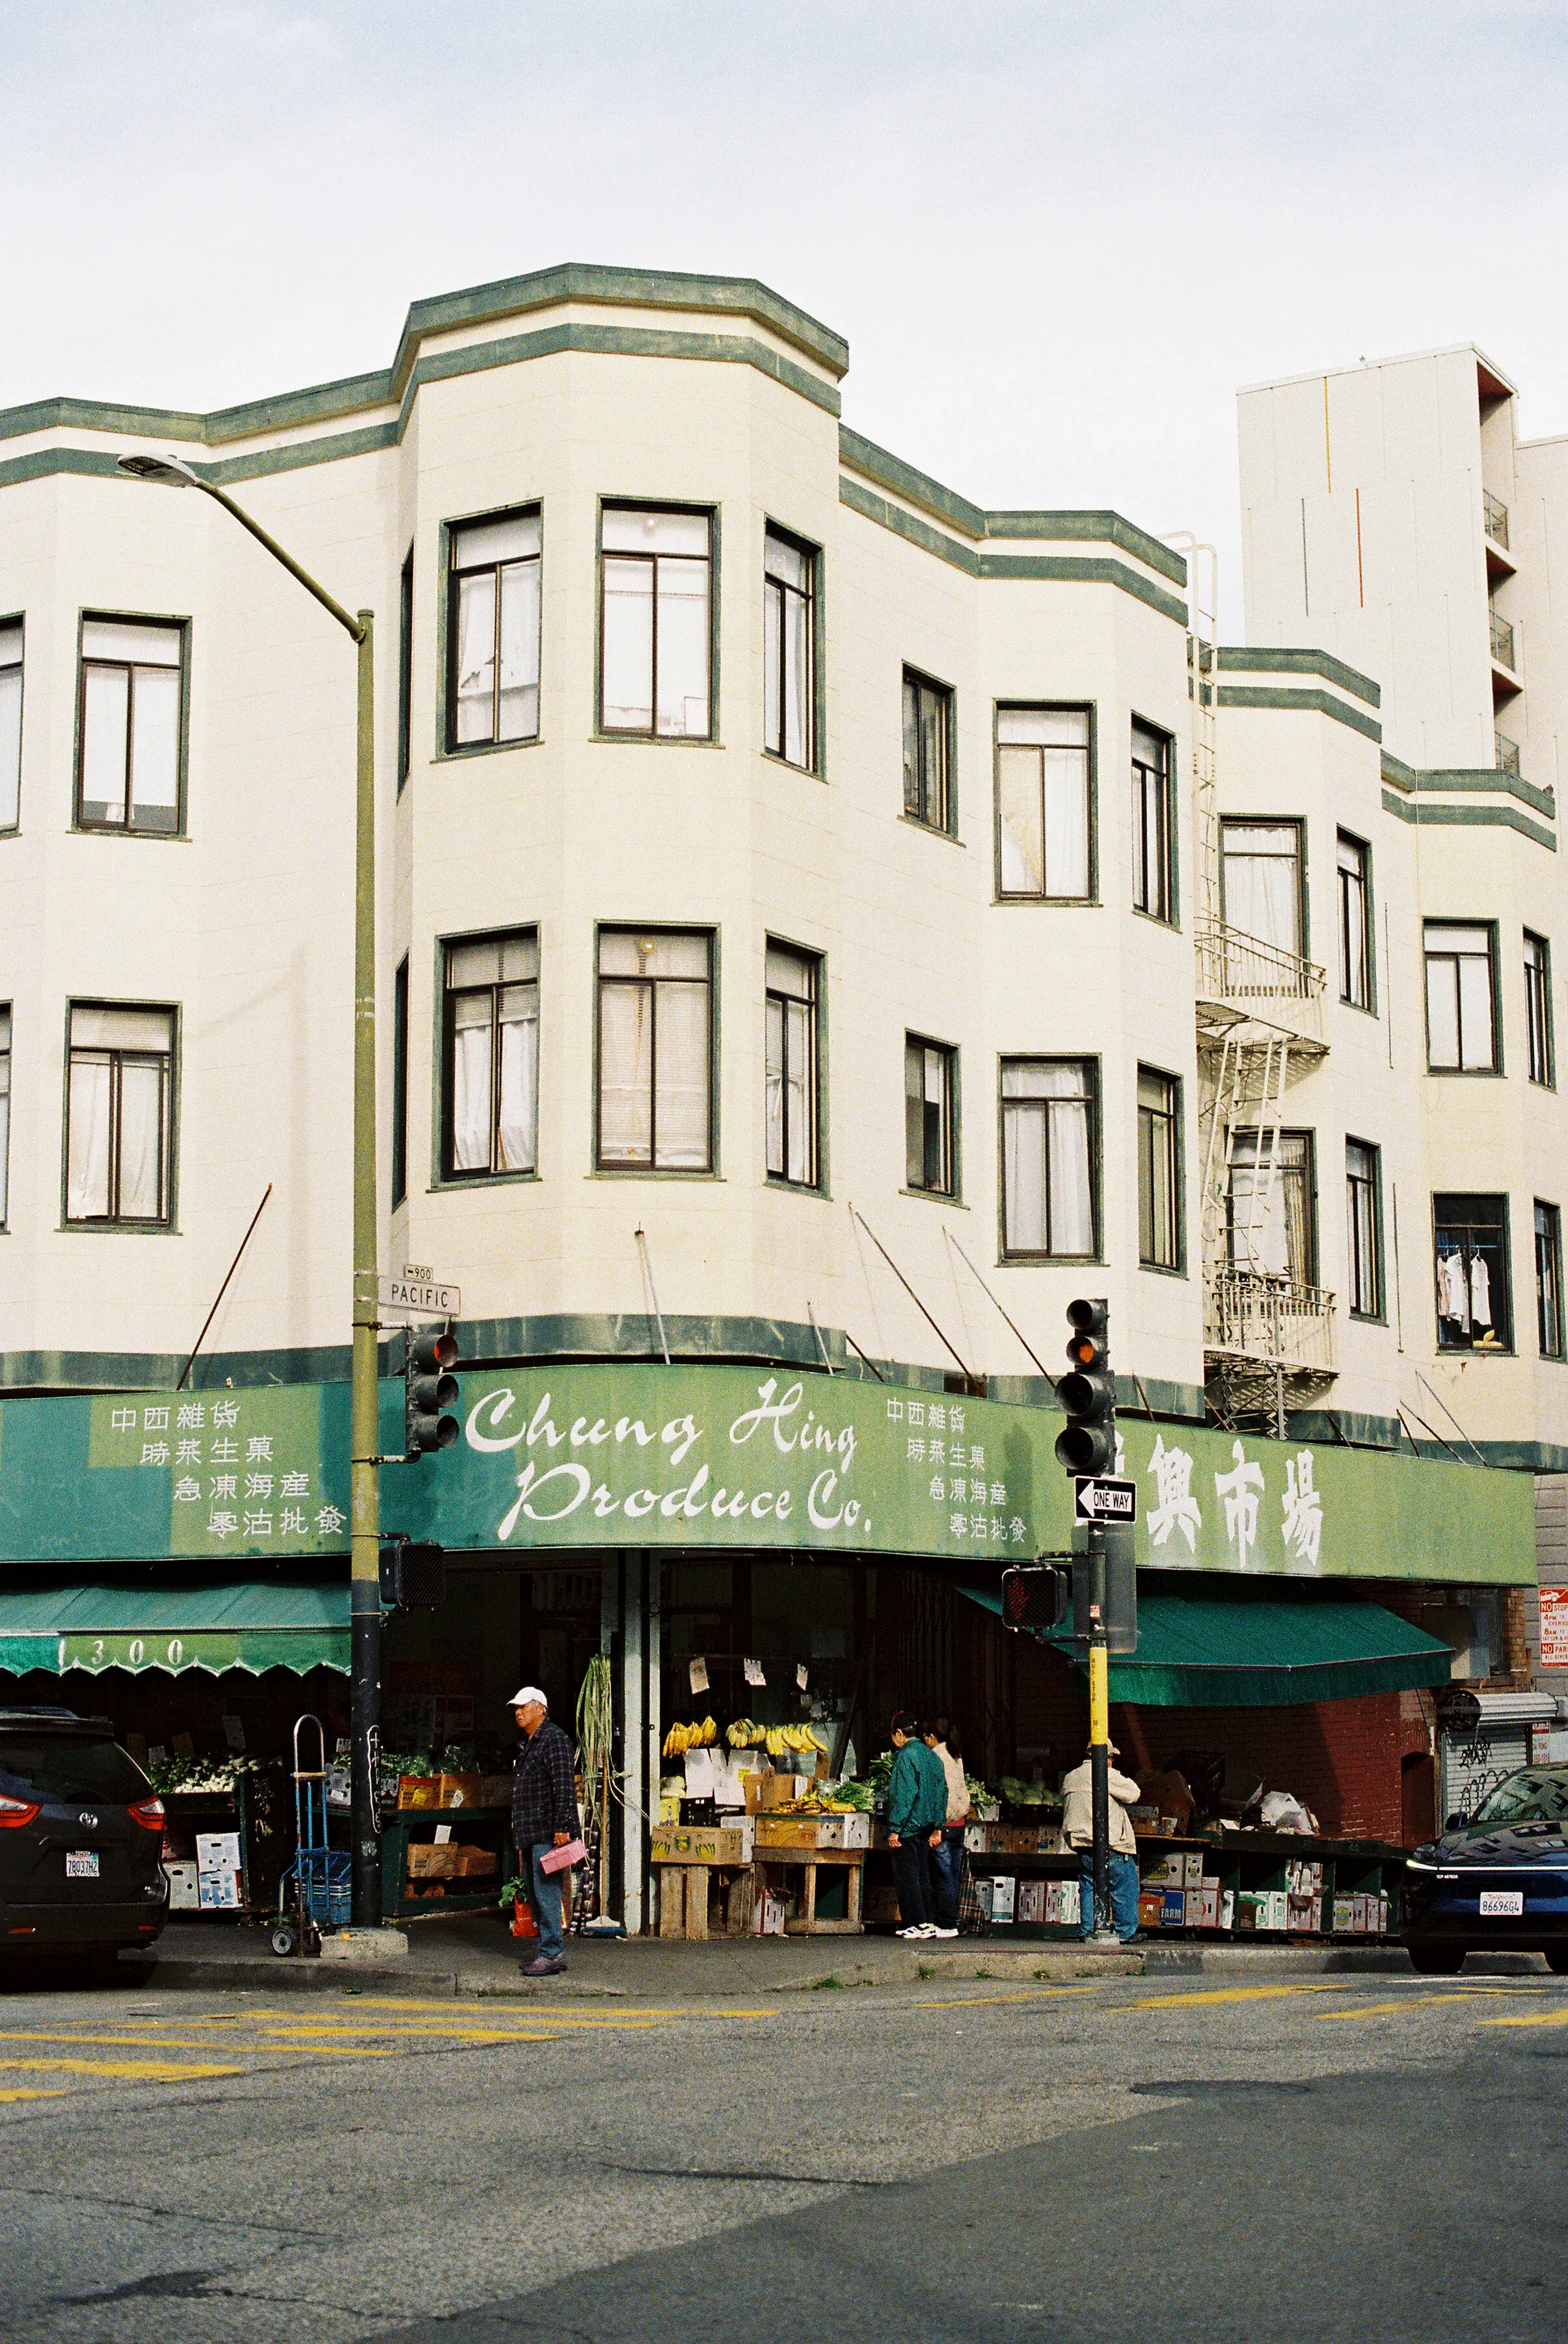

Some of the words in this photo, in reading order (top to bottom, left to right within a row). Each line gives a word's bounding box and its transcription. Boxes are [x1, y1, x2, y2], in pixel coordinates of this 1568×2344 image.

[415, 1267, 431, 1280] 900
[391, 1284, 448, 1308] PACIFIC
[111, 1400, 240, 1431] 中西雜貨
[887, 1397, 966, 1433] 中西雜貨
[465, 1388, 703, 1465] Chung
[729, 1377, 858, 1473] Hing
[498, 1461, 793, 1541] Produce
[808, 1469, 871, 1532] Co.
[1094, 1491, 1110, 1507] ONE
[1113, 1493, 1129, 1509] WAY
[1541, 1602, 1552, 1611] NO
[1542, 1644, 1552, 1653] NO
[68, 1860, 98, 1874] 78037H2
[1161, 1907, 1182, 1919] FARM
[1483, 1900, 1519, 1912] 86696G4
